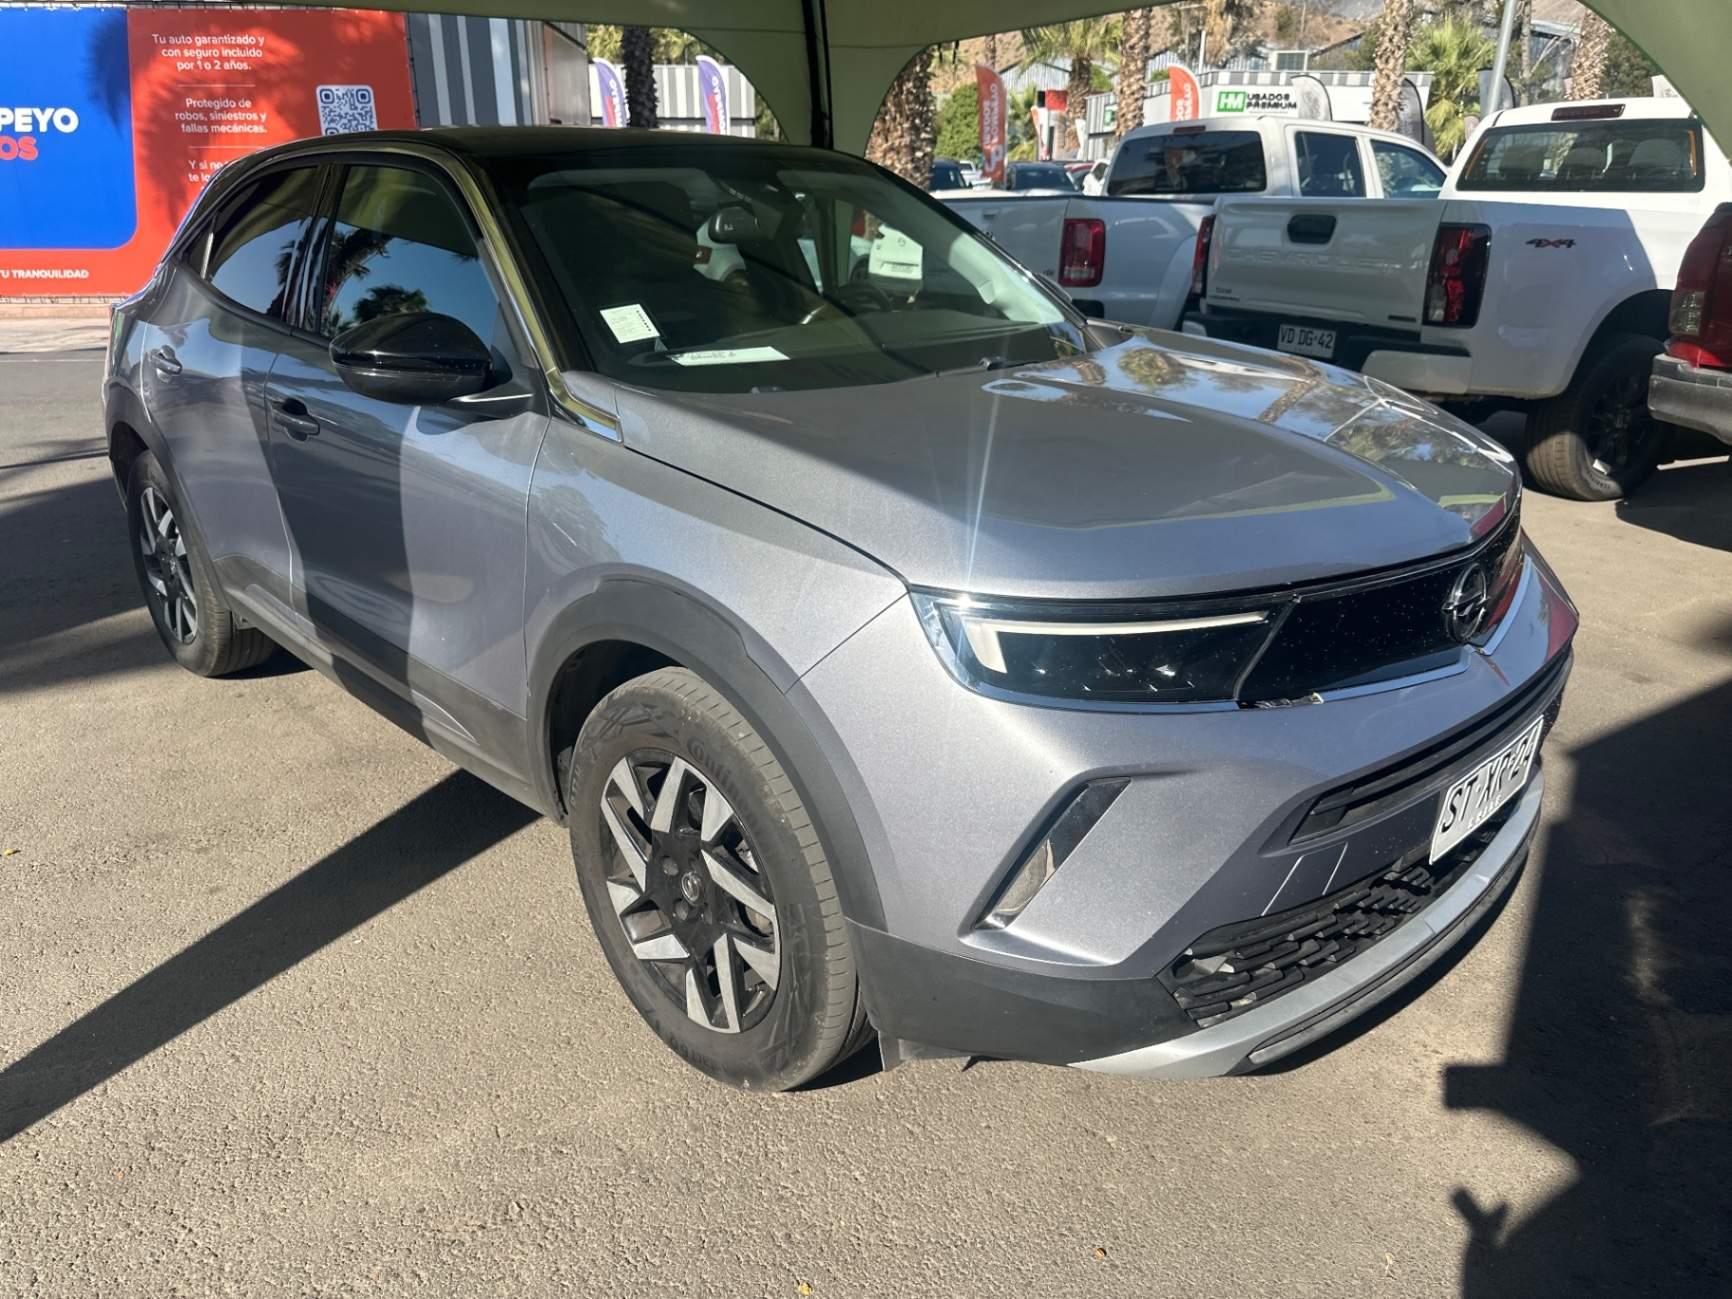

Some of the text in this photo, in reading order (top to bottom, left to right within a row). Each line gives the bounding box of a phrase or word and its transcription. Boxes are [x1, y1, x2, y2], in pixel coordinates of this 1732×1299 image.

[152, 34, 265, 46] Tu auto garantizado y
[161, 47, 263, 59] con seguro incluido
[176, 60, 252, 71] por 1 o 2 años.
[1218, 91, 1246, 111] HM
[1247, 93, 1290, 101] USADOS
[186, 98, 252, 109] Protegido de
[0, 107, 79, 133] PEYO
[175, 111, 267, 122] robos, siniestros y
[181, 123, 267, 133] fallas mecánicas.
[0, 136, 39, 160] OS
[188, 160, 197, 169] Y
[199, 160, 208, 169] si
[188, 173, 200, 182] te
[11, 269, 89, 279] TRANQUILIDAD
[1280, 327, 1295, 344] VD
